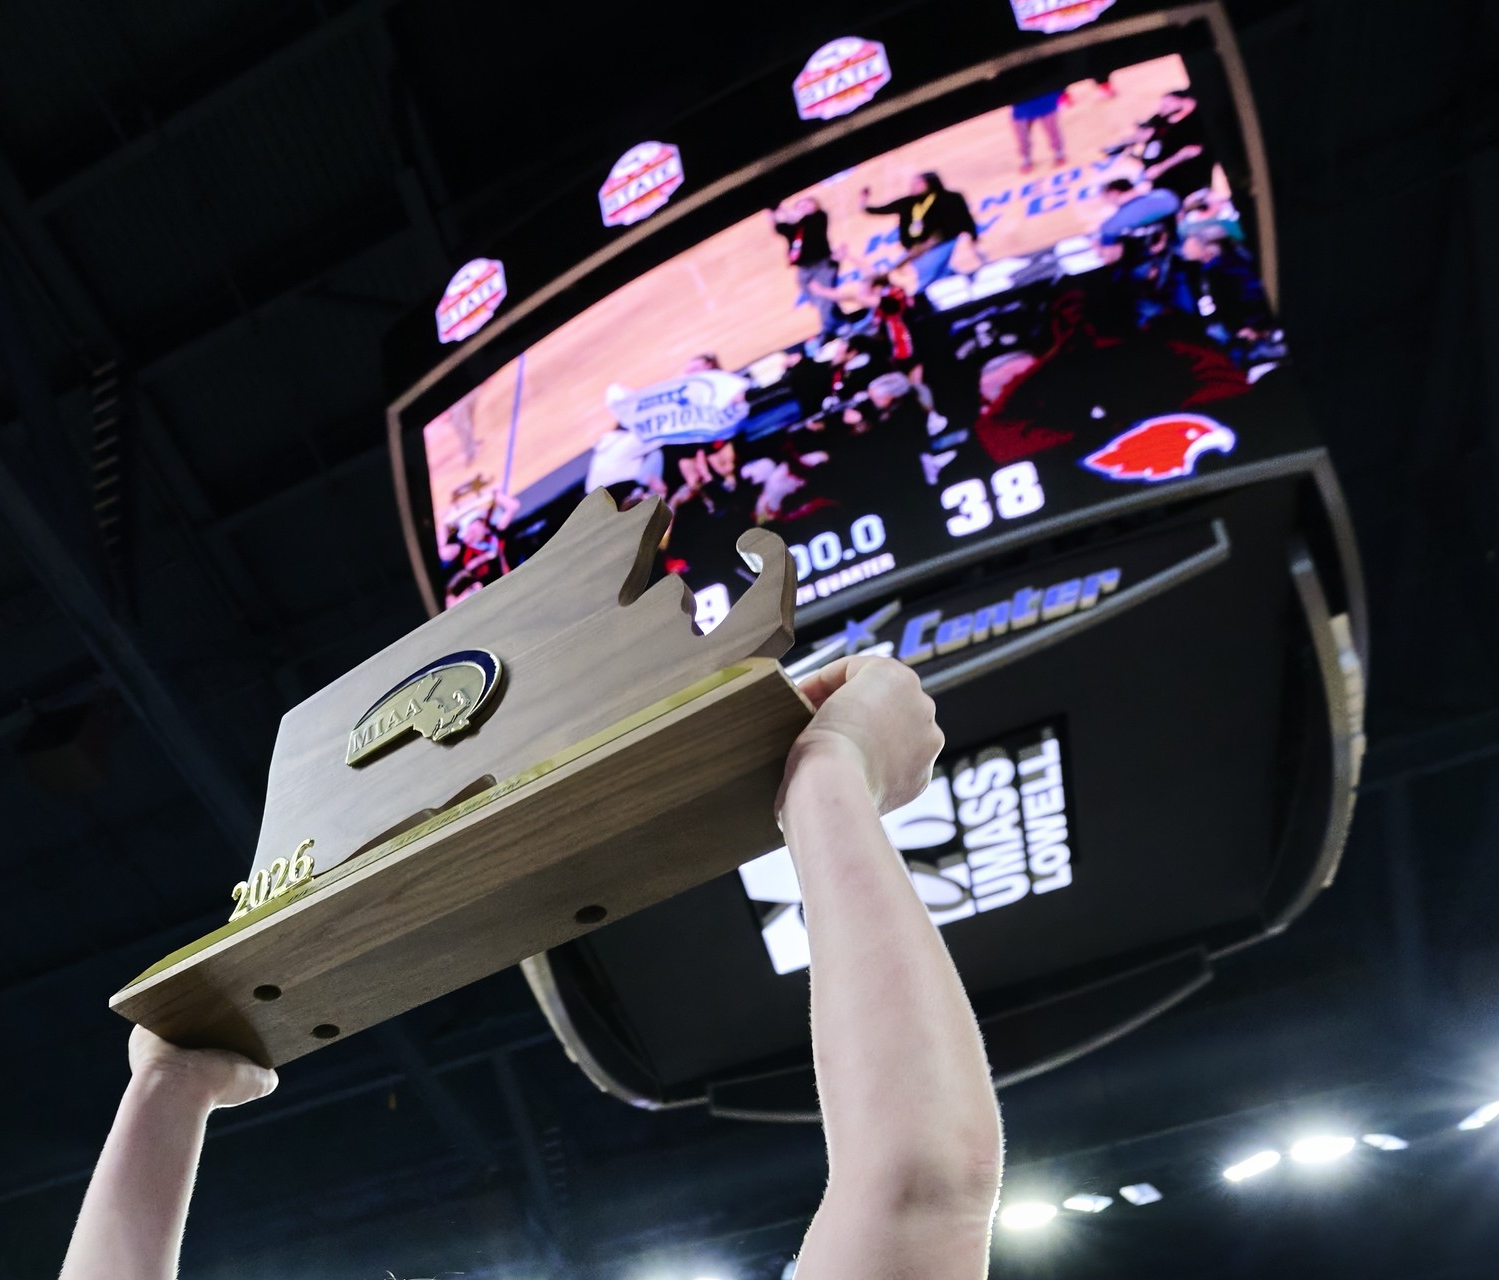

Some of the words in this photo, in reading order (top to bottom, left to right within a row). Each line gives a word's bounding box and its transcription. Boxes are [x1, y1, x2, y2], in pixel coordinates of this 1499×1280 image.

[940, 460, 1045, 538] 38
[815, 552, 896, 598] QUARTER
[898, 567, 1122, 665] Center
[352, 697, 424, 755] MIAA
[952, 757, 1031, 914] UMASS
[1017, 737, 1073, 895] LOWELL
[229, 838, 316, 923] 2026
